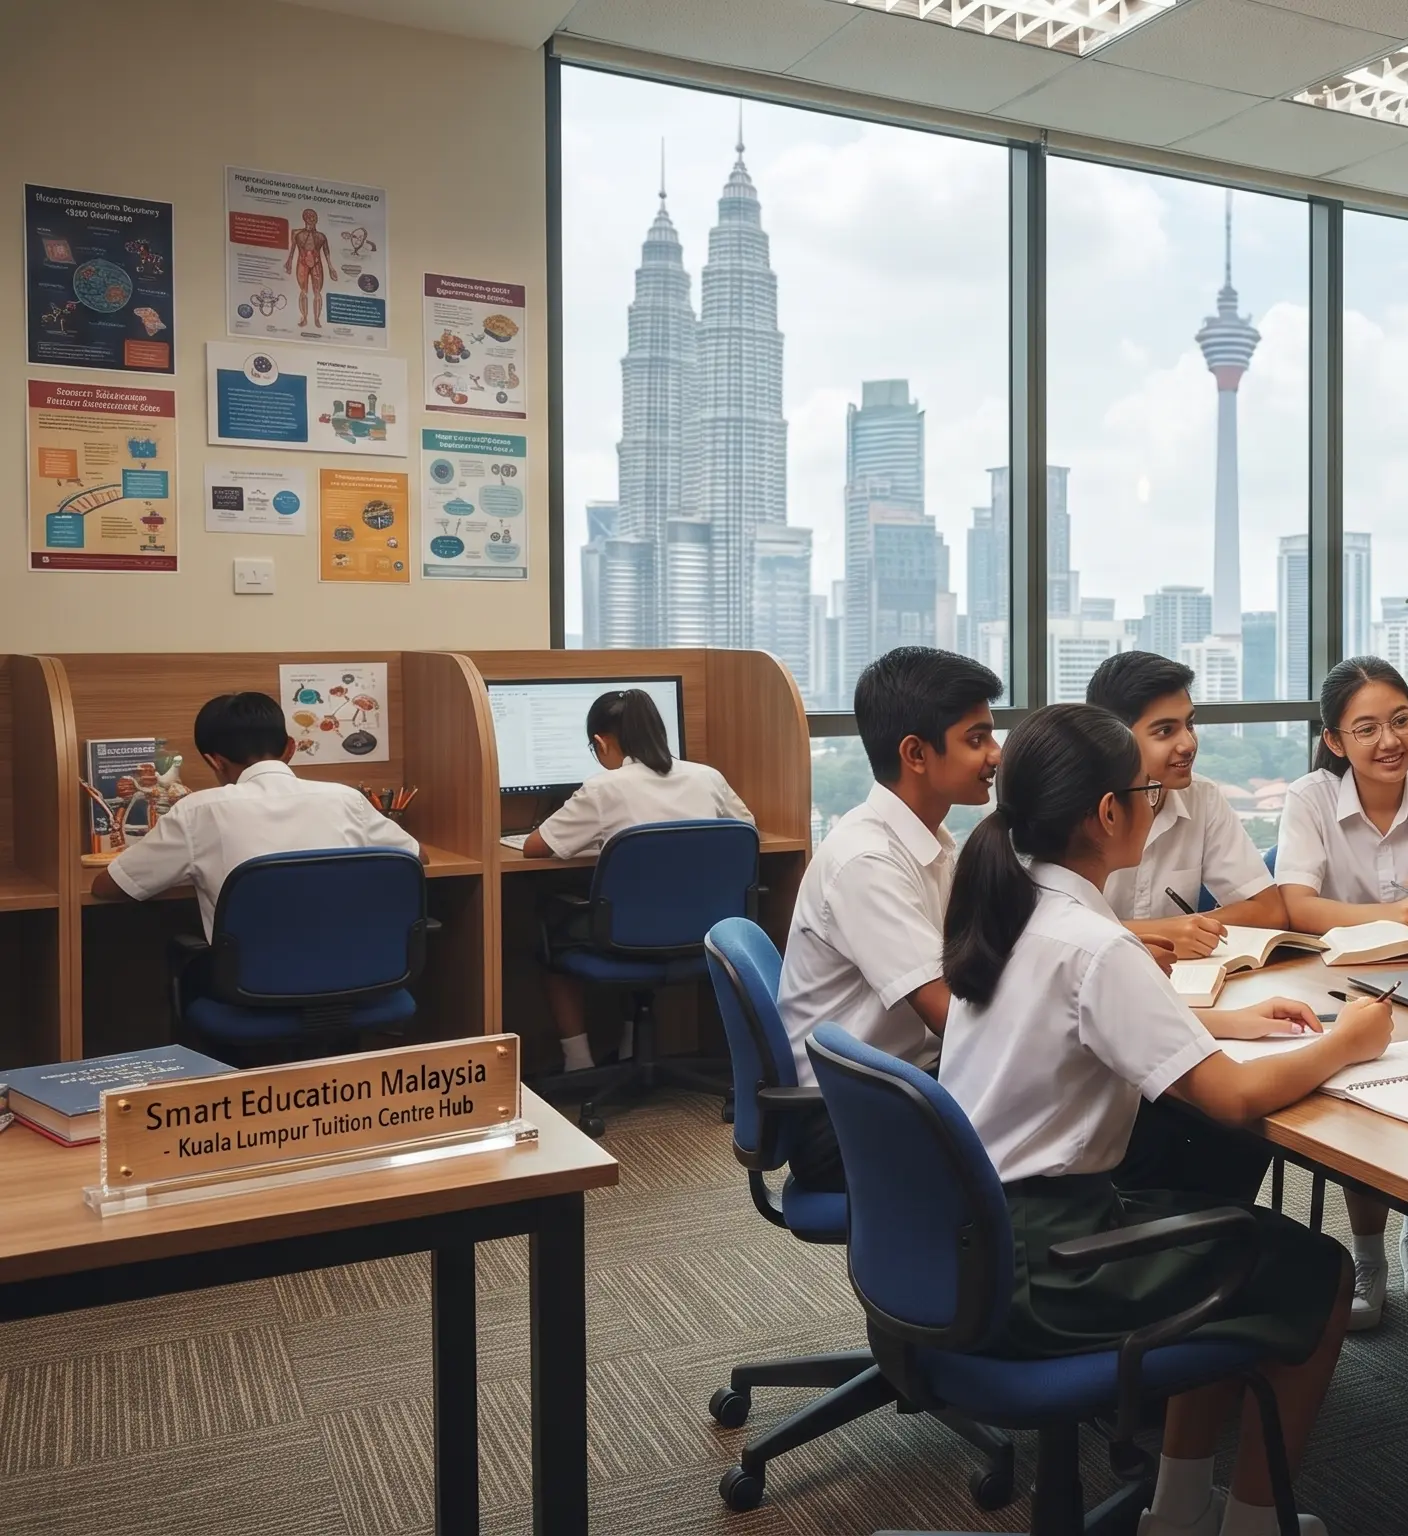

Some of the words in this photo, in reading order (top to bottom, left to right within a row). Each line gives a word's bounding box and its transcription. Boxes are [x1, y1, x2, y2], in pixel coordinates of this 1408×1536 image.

[146, 1096, 232, 1131] Smart
[241, 1078, 372, 1118] Education
[381, 1058, 487, 1098] Malaysia
[178, 1133, 232, 1158] Kuala
[237, 1123, 309, 1154] Lumpur
[312, 1114, 372, 1137] Tuition
[378, 1105, 434, 1127] Centre
[439, 1095, 474, 1118] Hub
